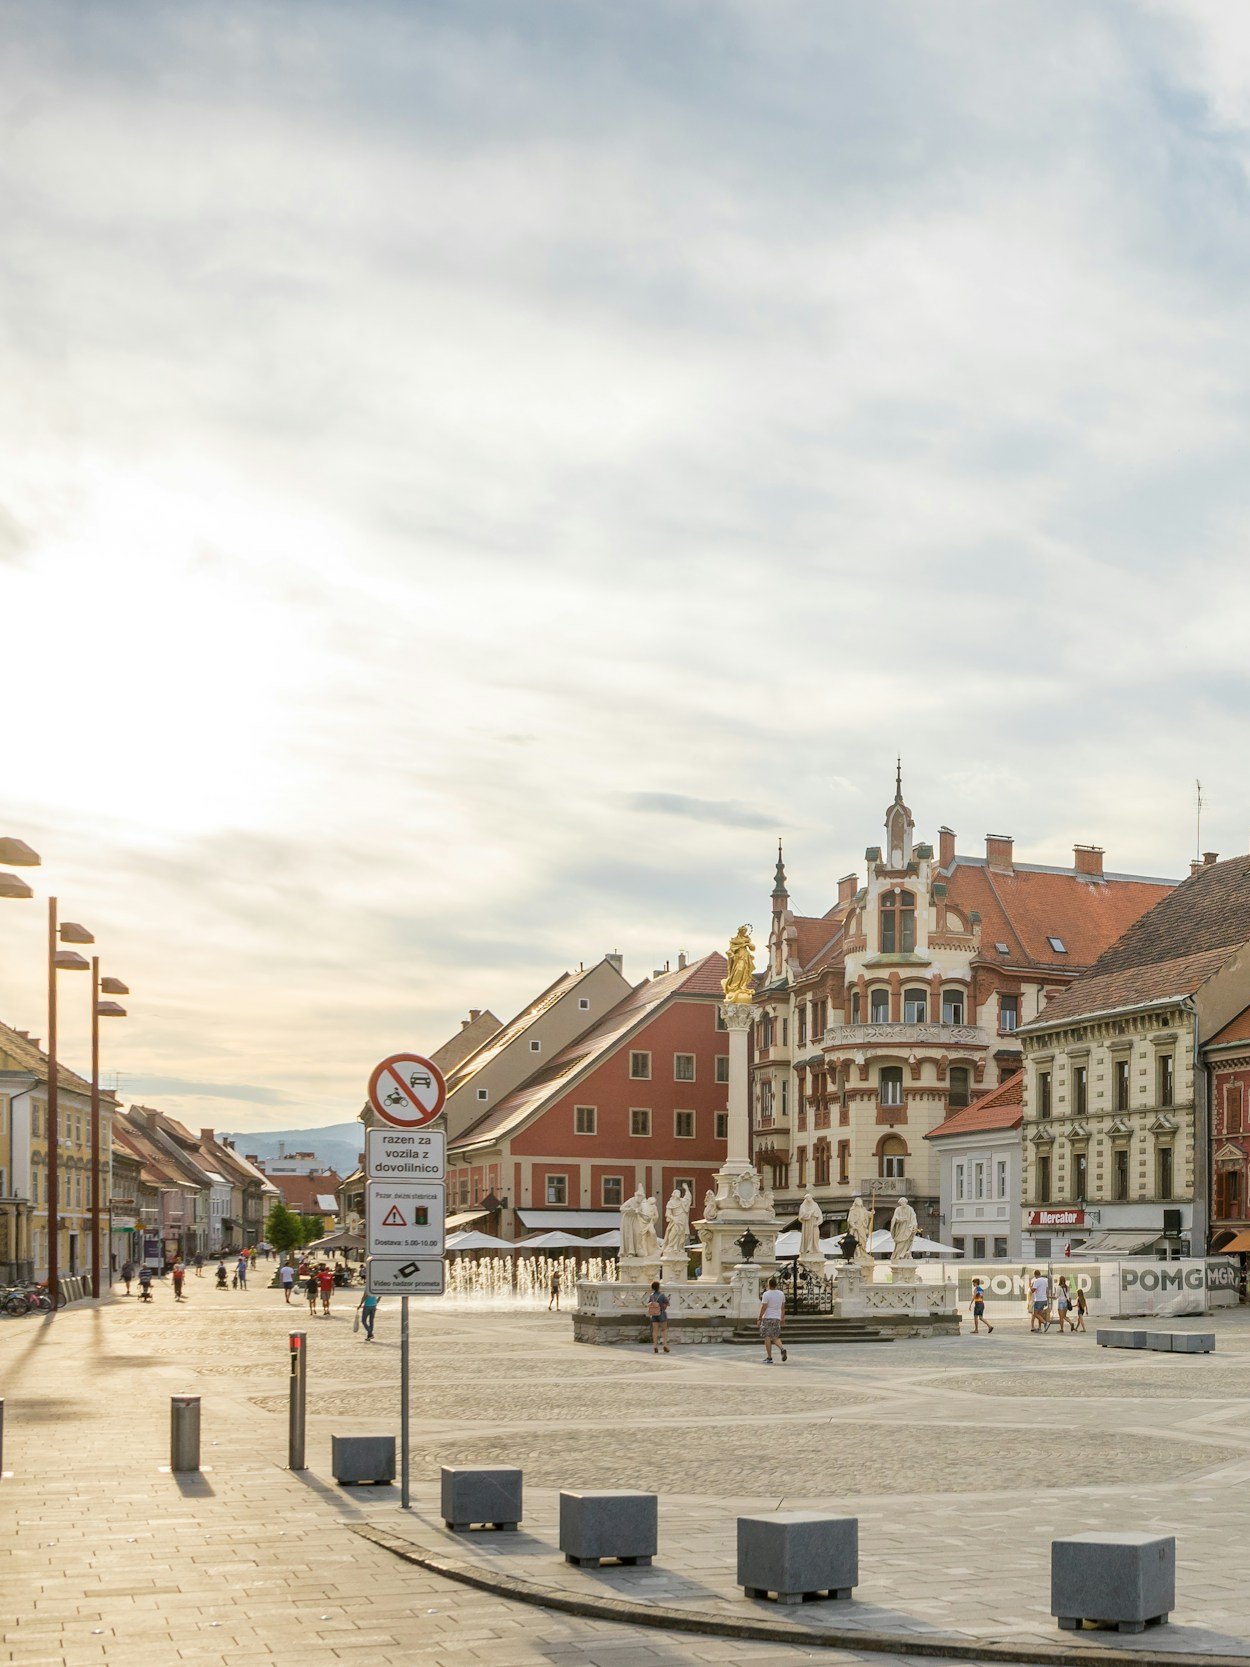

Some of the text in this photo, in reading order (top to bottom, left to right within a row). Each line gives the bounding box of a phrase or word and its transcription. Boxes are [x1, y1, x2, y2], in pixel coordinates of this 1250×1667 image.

[383, 1136, 431, 1145] razen za
[385, 1149, 429, 1159] vozila z
[375, 1162, 439, 1173] dovolilnico
[1040, 1211, 1078, 1225] Mercator
